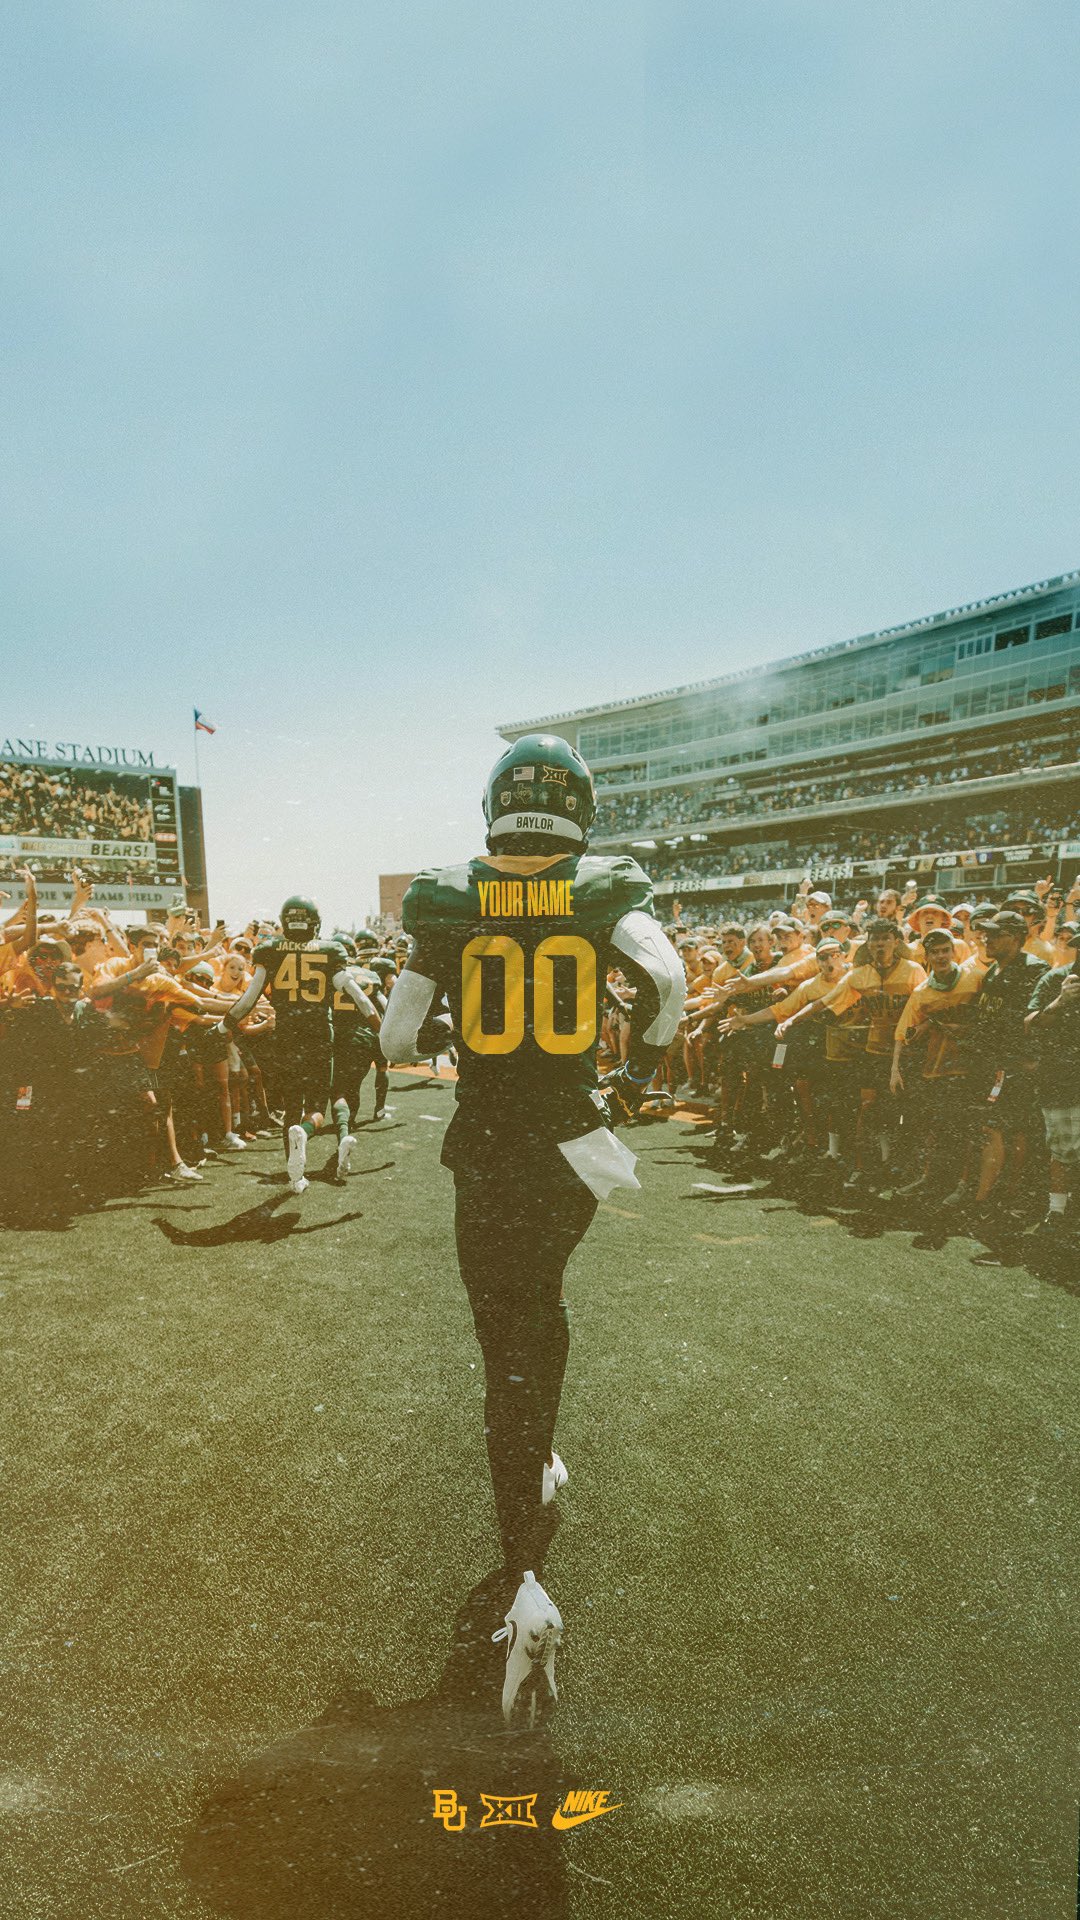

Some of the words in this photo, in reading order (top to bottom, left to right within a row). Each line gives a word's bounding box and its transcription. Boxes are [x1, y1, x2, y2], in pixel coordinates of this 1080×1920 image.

[55, 742, 155, 767] STADIUM
[516, 816, 554, 831] BAYLOR
[91, 843, 149, 858] BEARS!
[18, 889, 56, 900] EDIE
[62, 890, 124, 902] WIAMS
[477, 880, 524, 917] YOUR
[527, 879, 575, 917] NAME
[275, 940, 320, 952] JACKSON
[273, 953, 328, 1003] 45
[461, 935, 597, 1055] 00
